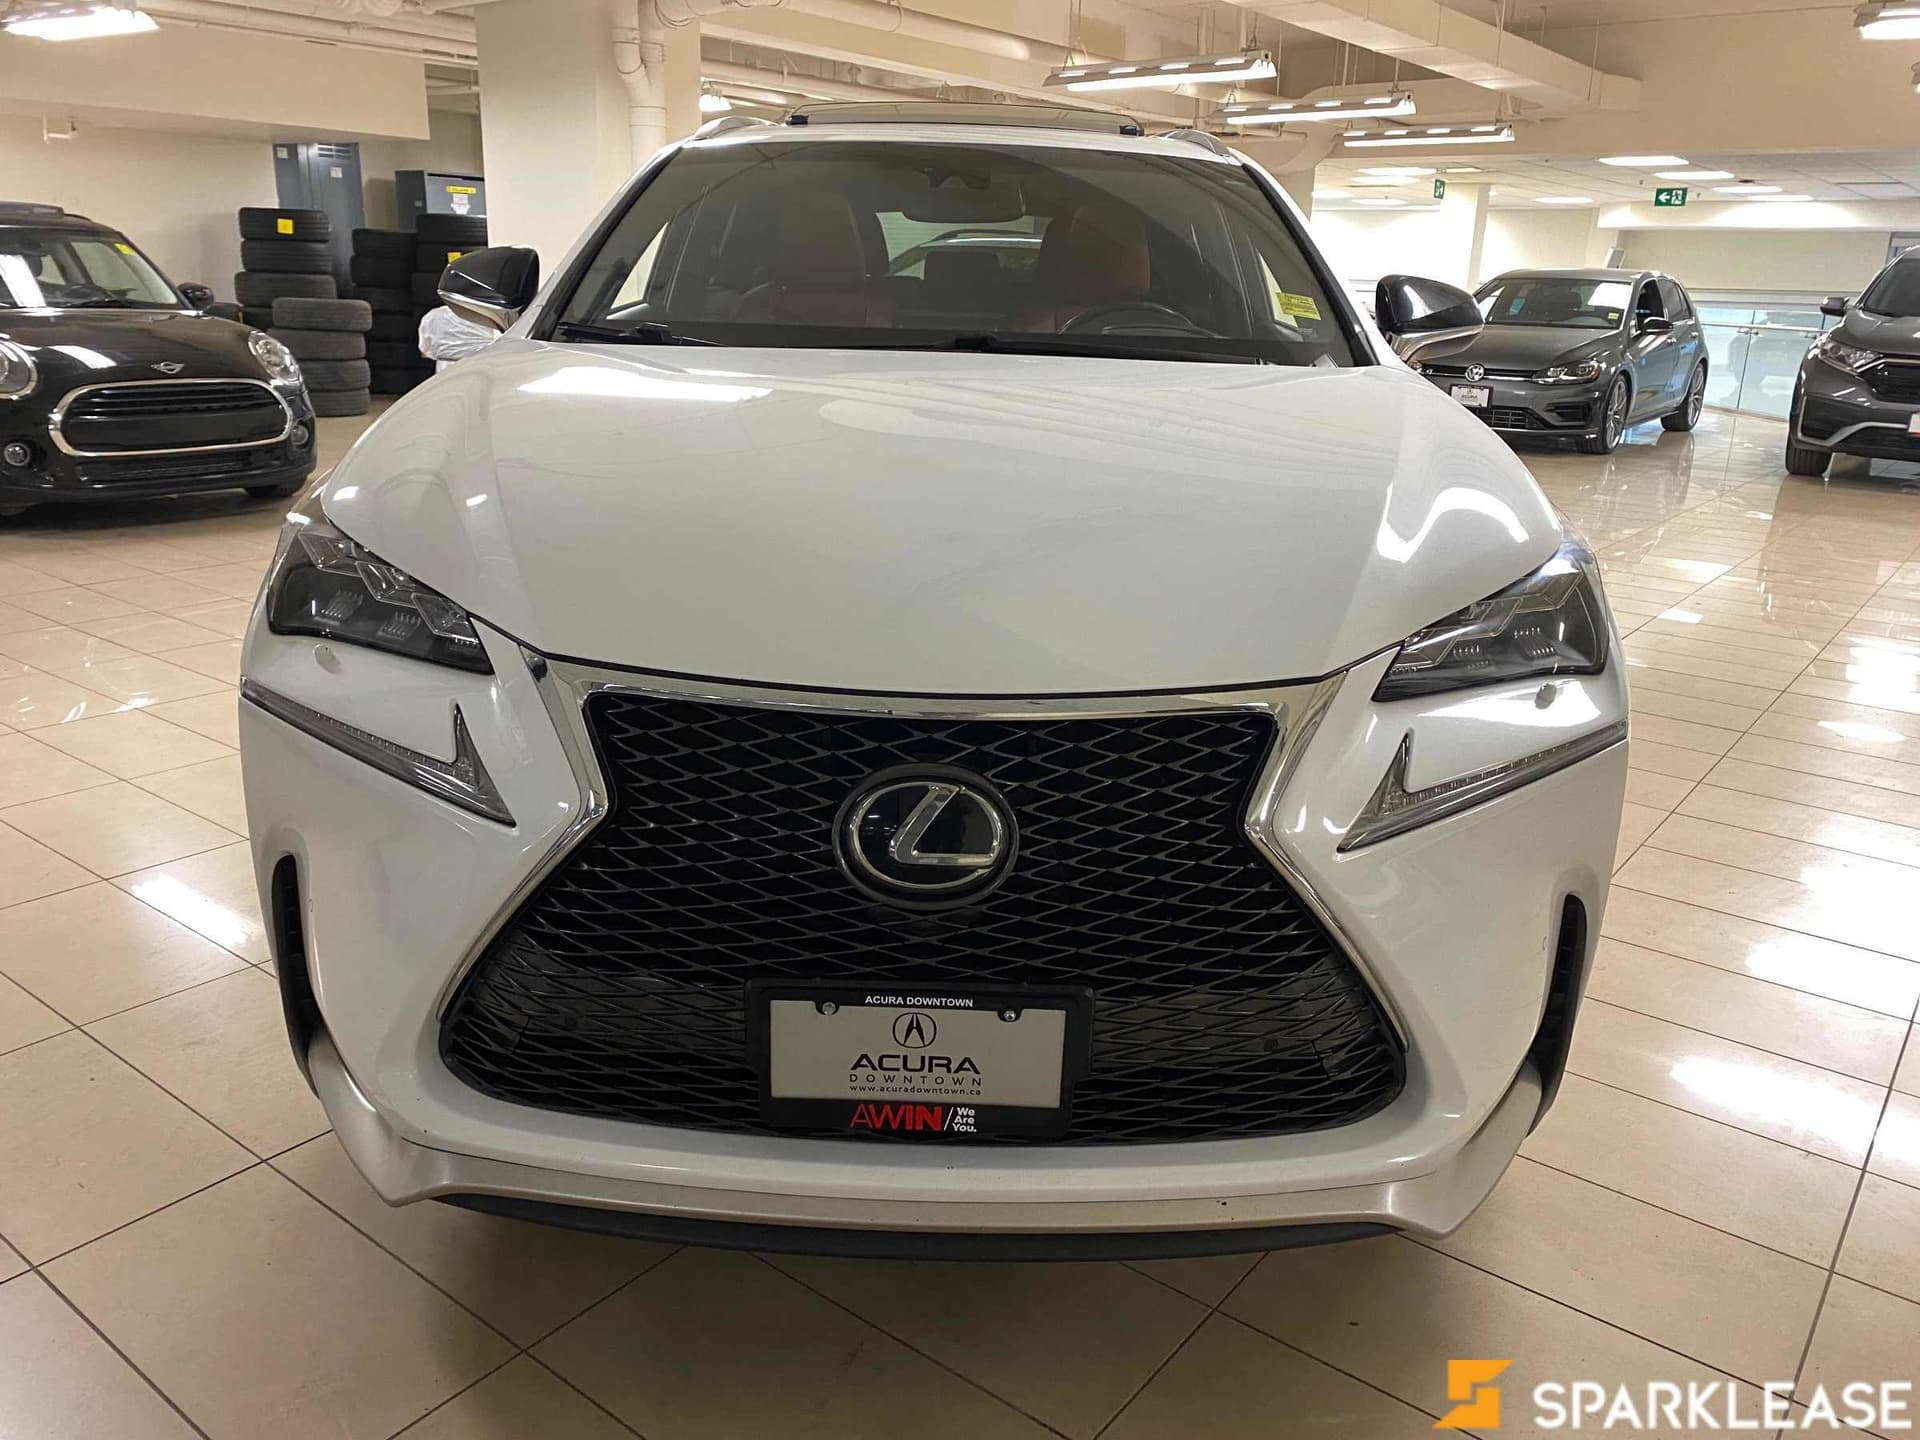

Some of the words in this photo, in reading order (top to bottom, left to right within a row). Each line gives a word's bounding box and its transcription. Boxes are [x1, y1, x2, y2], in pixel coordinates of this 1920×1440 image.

[865, 995, 904, 1005] ACURA
[906, 996, 973, 1007] DOWNTOWN
[850, 1053, 981, 1075] ACURA
[848, 1073, 982, 1087] DOWNTOWN
[848, 1084, 982, 1096] www.acuradowntown.ca
[849, 1103, 943, 1131] AWIN
[957, 1107, 975, 1117] We
[954, 1116, 975, 1125] Are
[952, 1123, 977, 1132] You.
